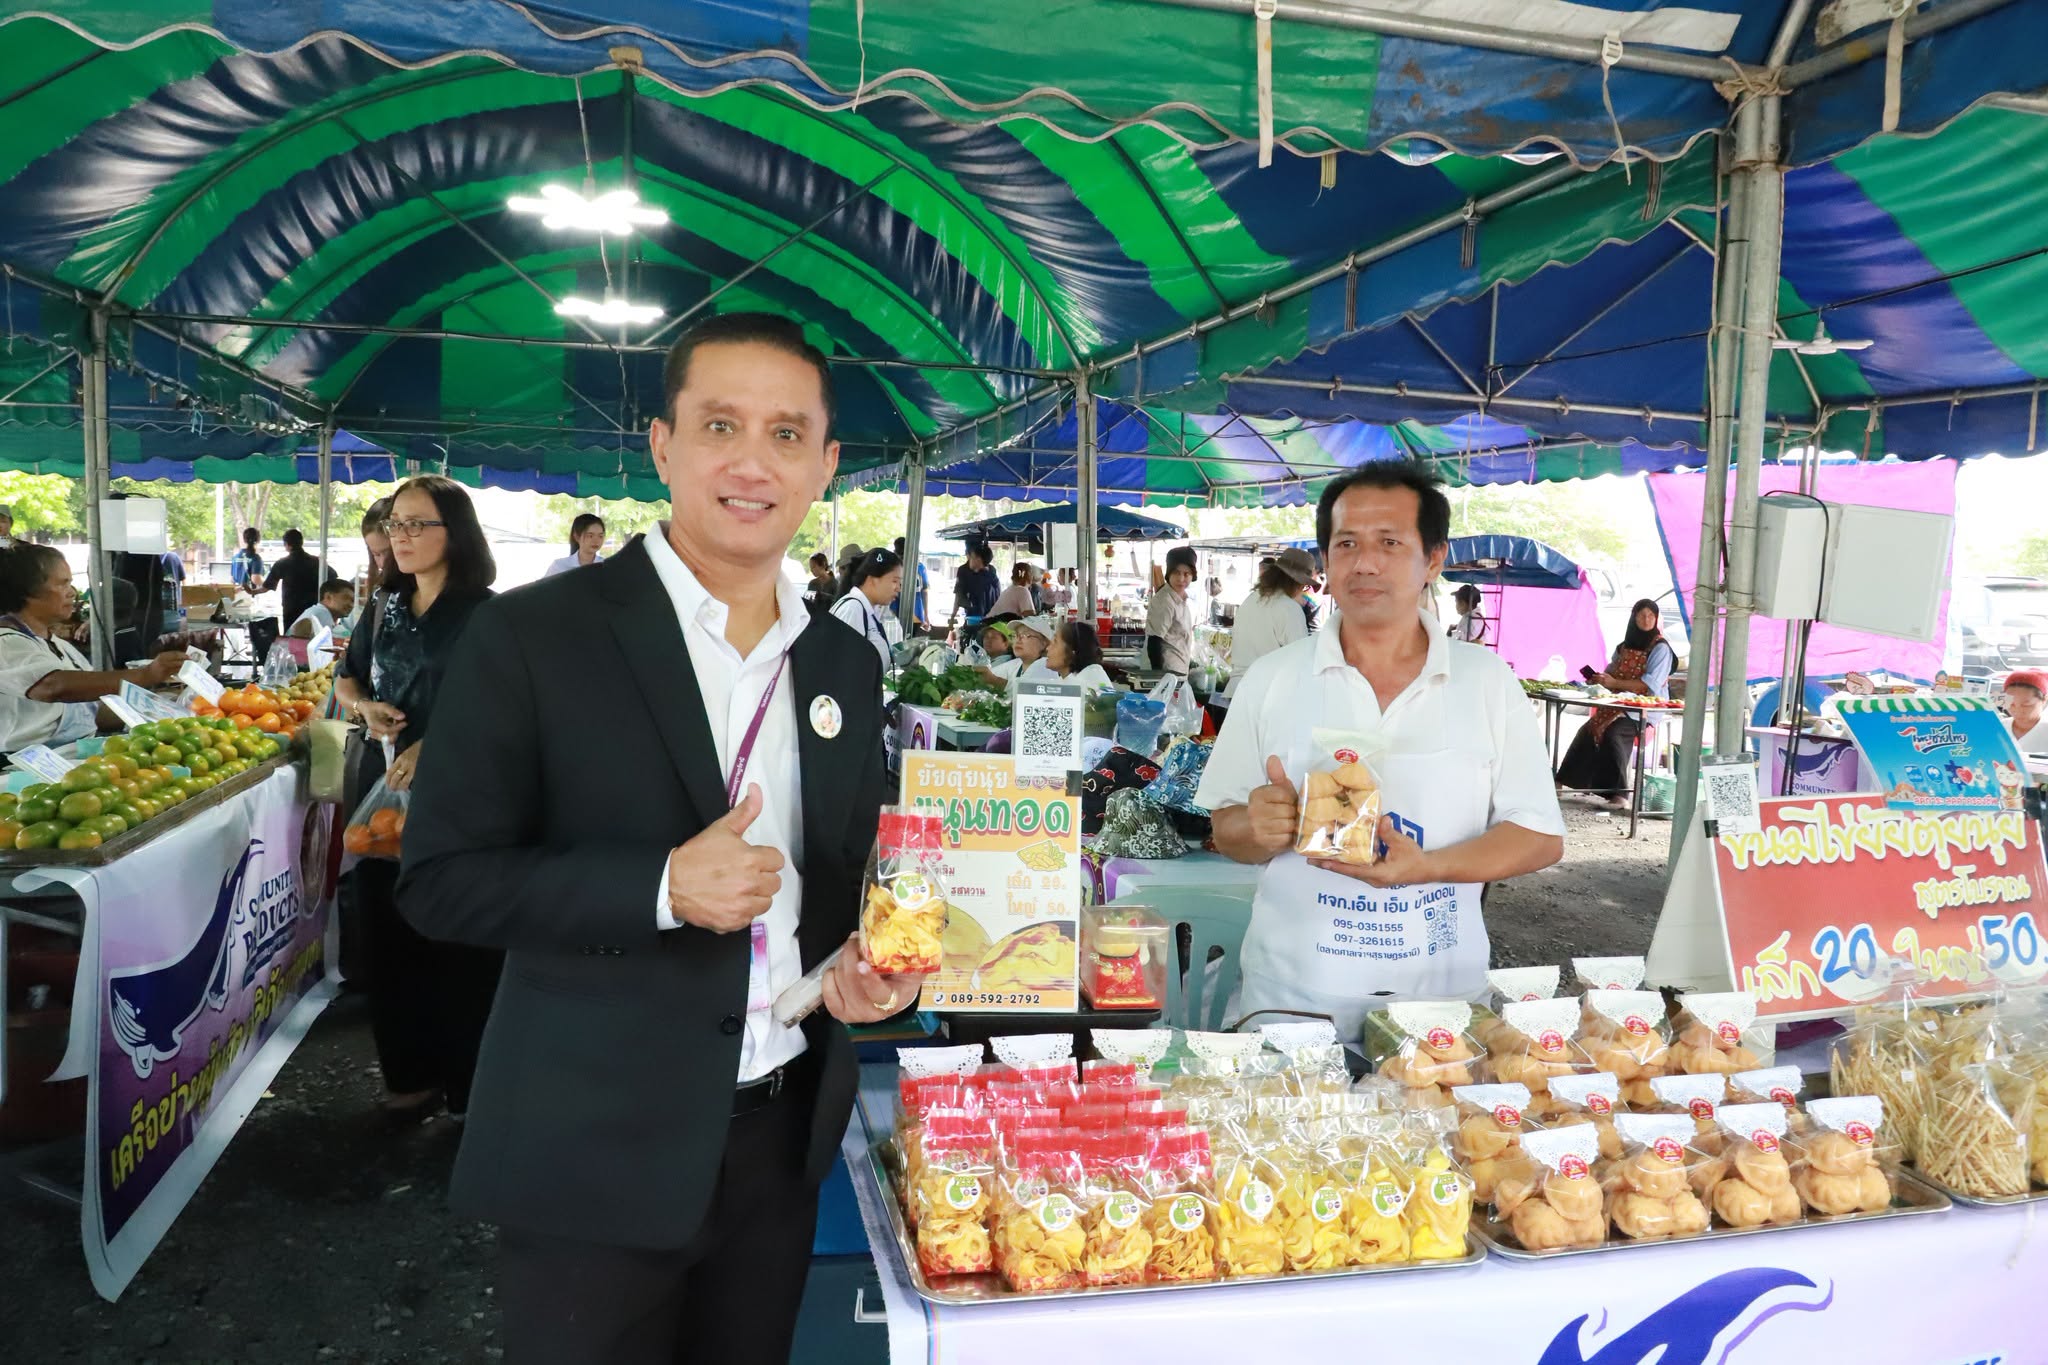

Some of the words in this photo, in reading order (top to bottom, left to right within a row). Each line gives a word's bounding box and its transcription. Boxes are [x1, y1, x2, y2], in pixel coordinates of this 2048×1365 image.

[1720, 801, 2027, 870] ขนมไข่ยัยตุยนุย
[950, 886, 986, 897] รสหวาน
[1317, 892, 1377, 913] หจก.เอ็น
[1384, 896, 1409, 913] เอ็ม
[1414, 886, 1456, 909] บ้านดอน
[1333, 918, 1404, 932] 095-0351555
[1334, 933, 1405, 946] 097-3261615
[1742, 930, 1822, 1002] เล็ก
[1892, 925, 1989, 983] ใหญ่
[950, 993, 1040, 1004] 089-592-2792
